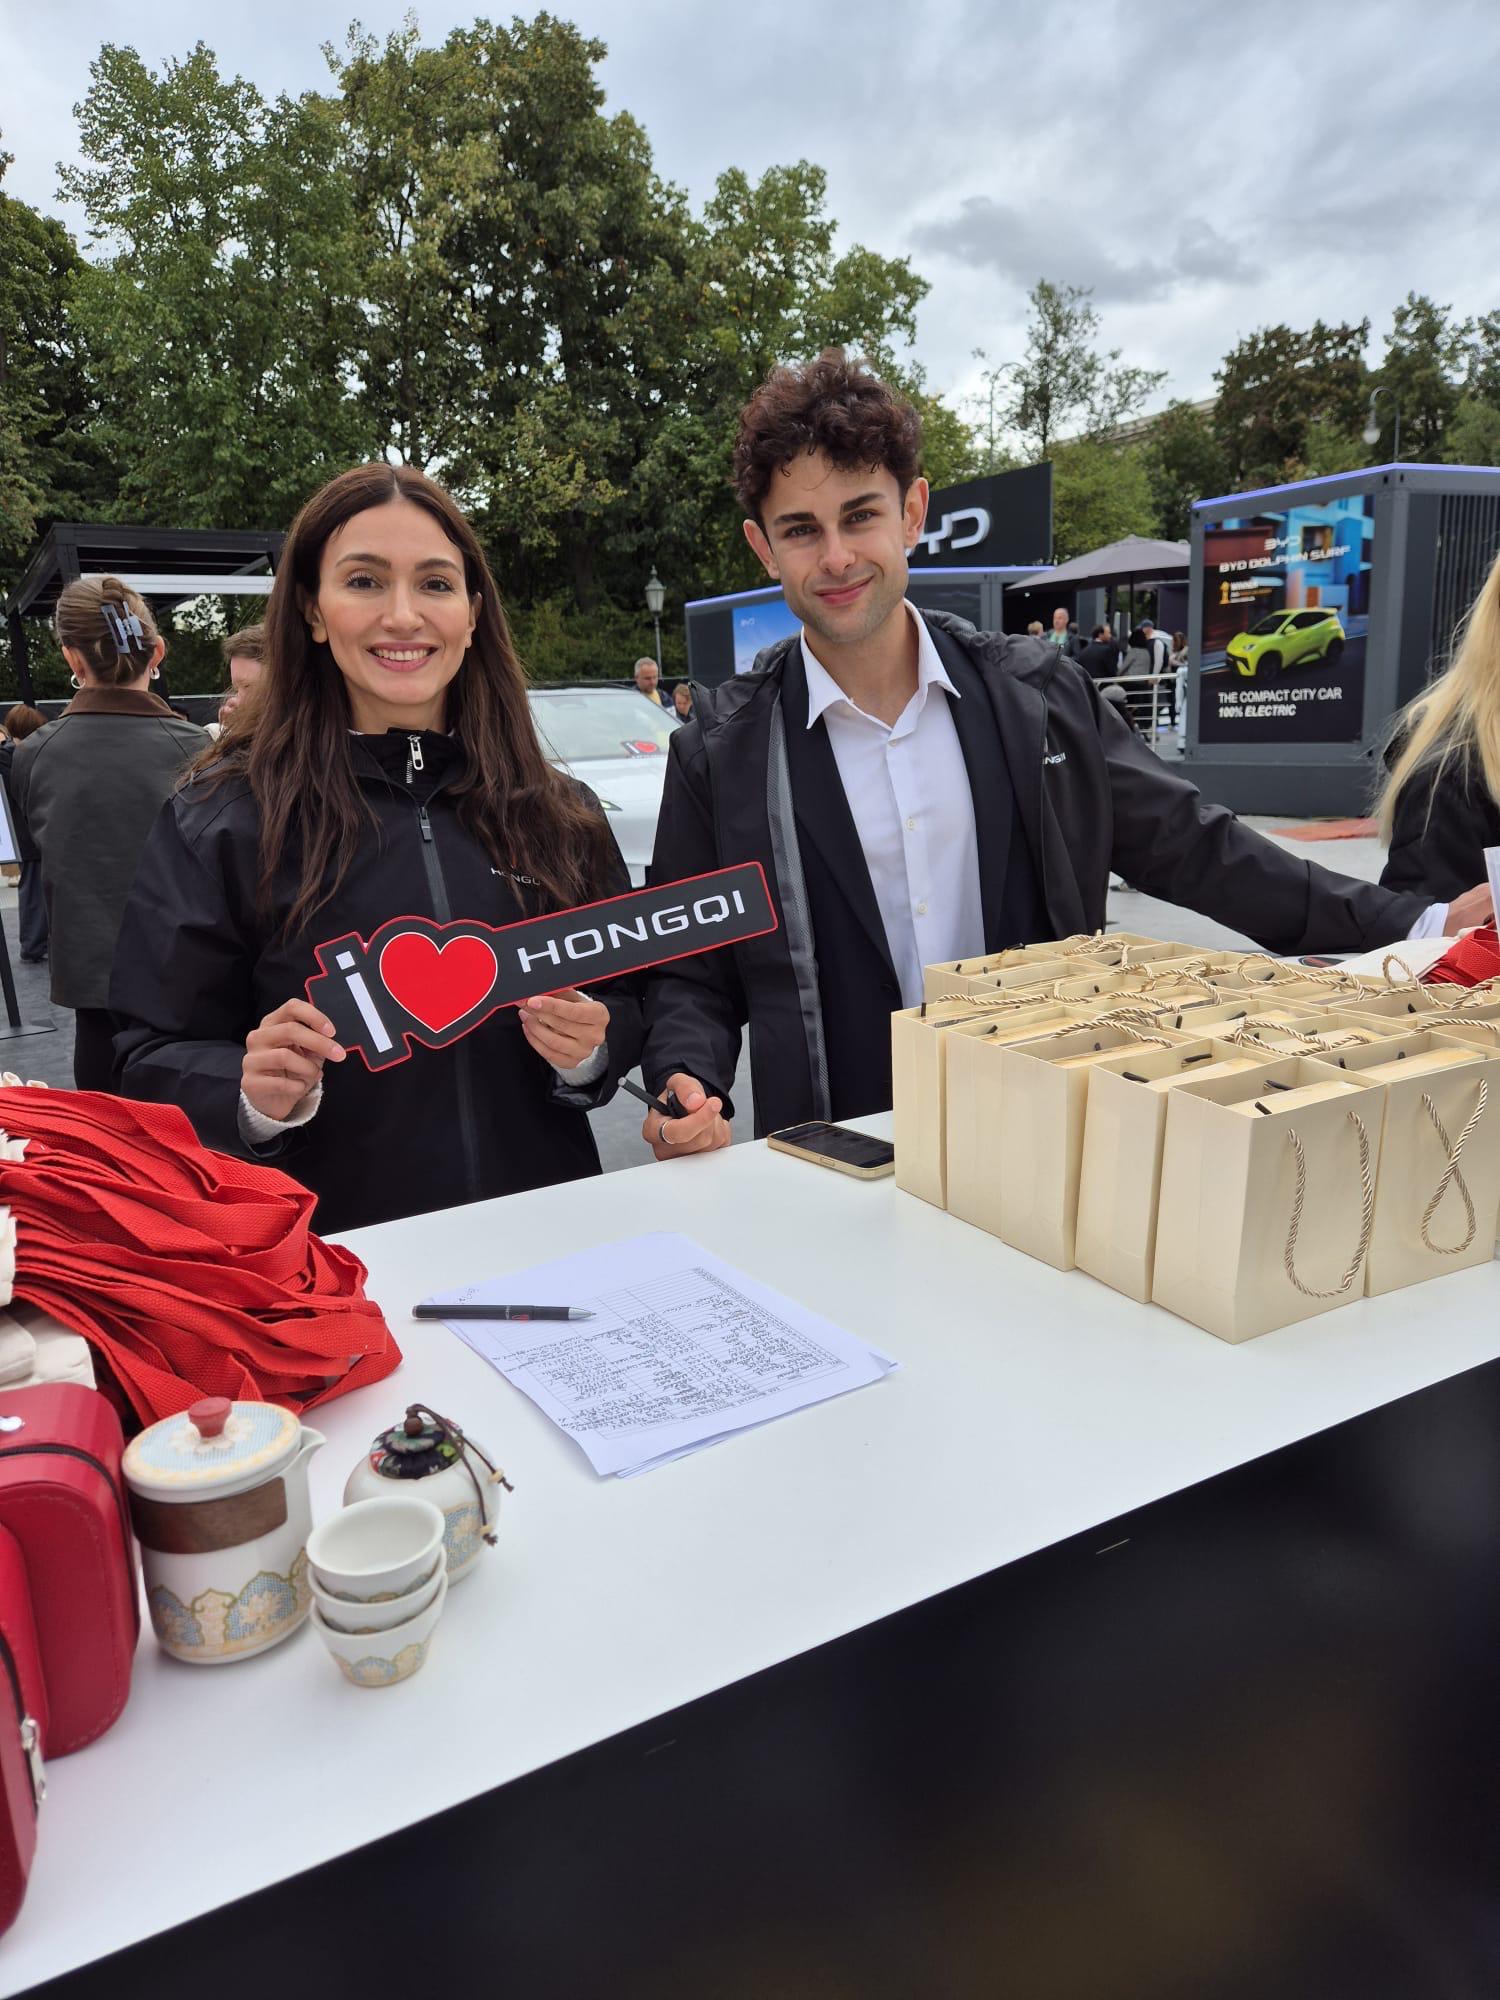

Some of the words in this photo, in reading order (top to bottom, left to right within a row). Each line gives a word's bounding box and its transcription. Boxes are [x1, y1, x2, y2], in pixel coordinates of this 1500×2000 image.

[905, 507, 990, 556] YD
[1264, 536, 1300, 550] BYD
[1219, 560, 1247, 573] BYD
[1249, 552, 1308, 569] DOLPHIN
[1309, 545, 1350, 560] SURF
[1218, 691, 1238, 703] THE
[1240, 689, 1290, 703] COMPACT
[1291, 687, 1316, 701] CITY
[1317, 686, 1342, 700] CAR
[1219, 706, 1243, 717] 100%
[1245, 704, 1296, 717] ELECTRIC
[516, 890, 746, 974] HONGQI
